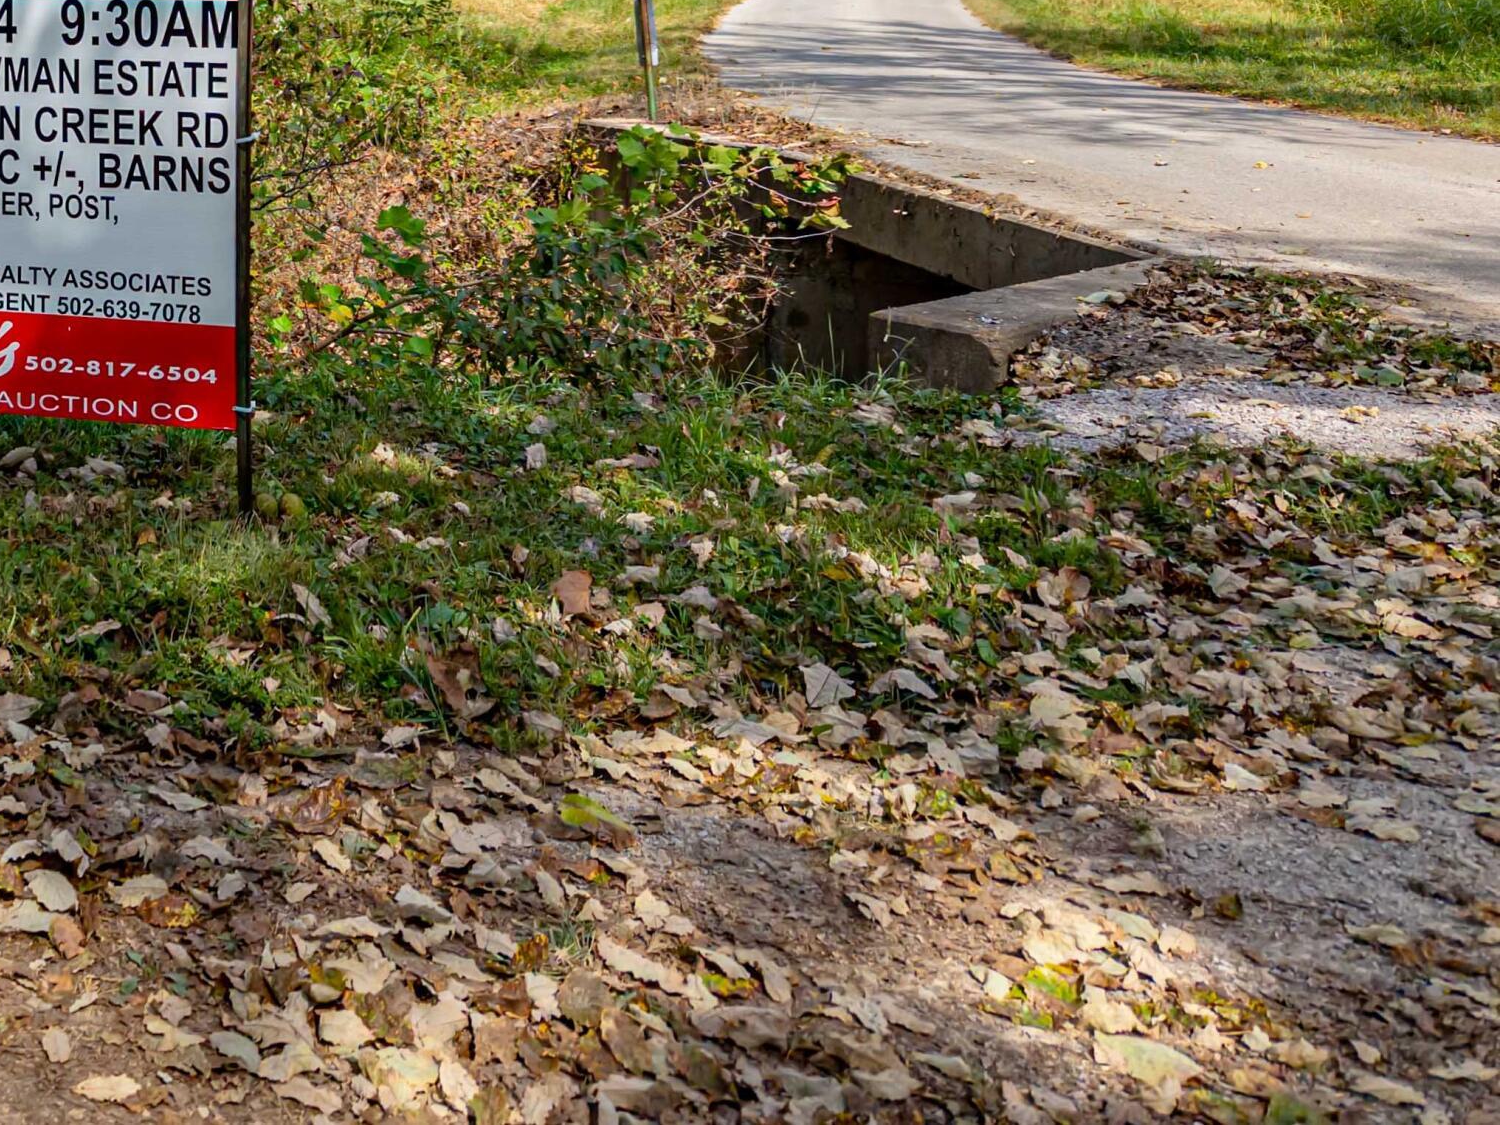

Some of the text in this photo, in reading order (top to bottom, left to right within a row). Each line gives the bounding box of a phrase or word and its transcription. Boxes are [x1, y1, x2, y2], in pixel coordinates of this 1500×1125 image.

[61, 0, 239, 49] 9:30AM
[94, 61, 228, 99] ESTATE
[35, 107, 163, 146] CREEK
[177, 112, 228, 148] RD
[33, 152, 84, 193] +/-,
[99, 155, 230, 194] BARNS
[49, 195, 118, 224] POST,
[63, 268, 211, 296] ASSOCIATES
[57, 296, 201, 323] 502-639-7078
[25, 356, 217, 384] 502-817-6504
[151, 402, 198, 421] CO
